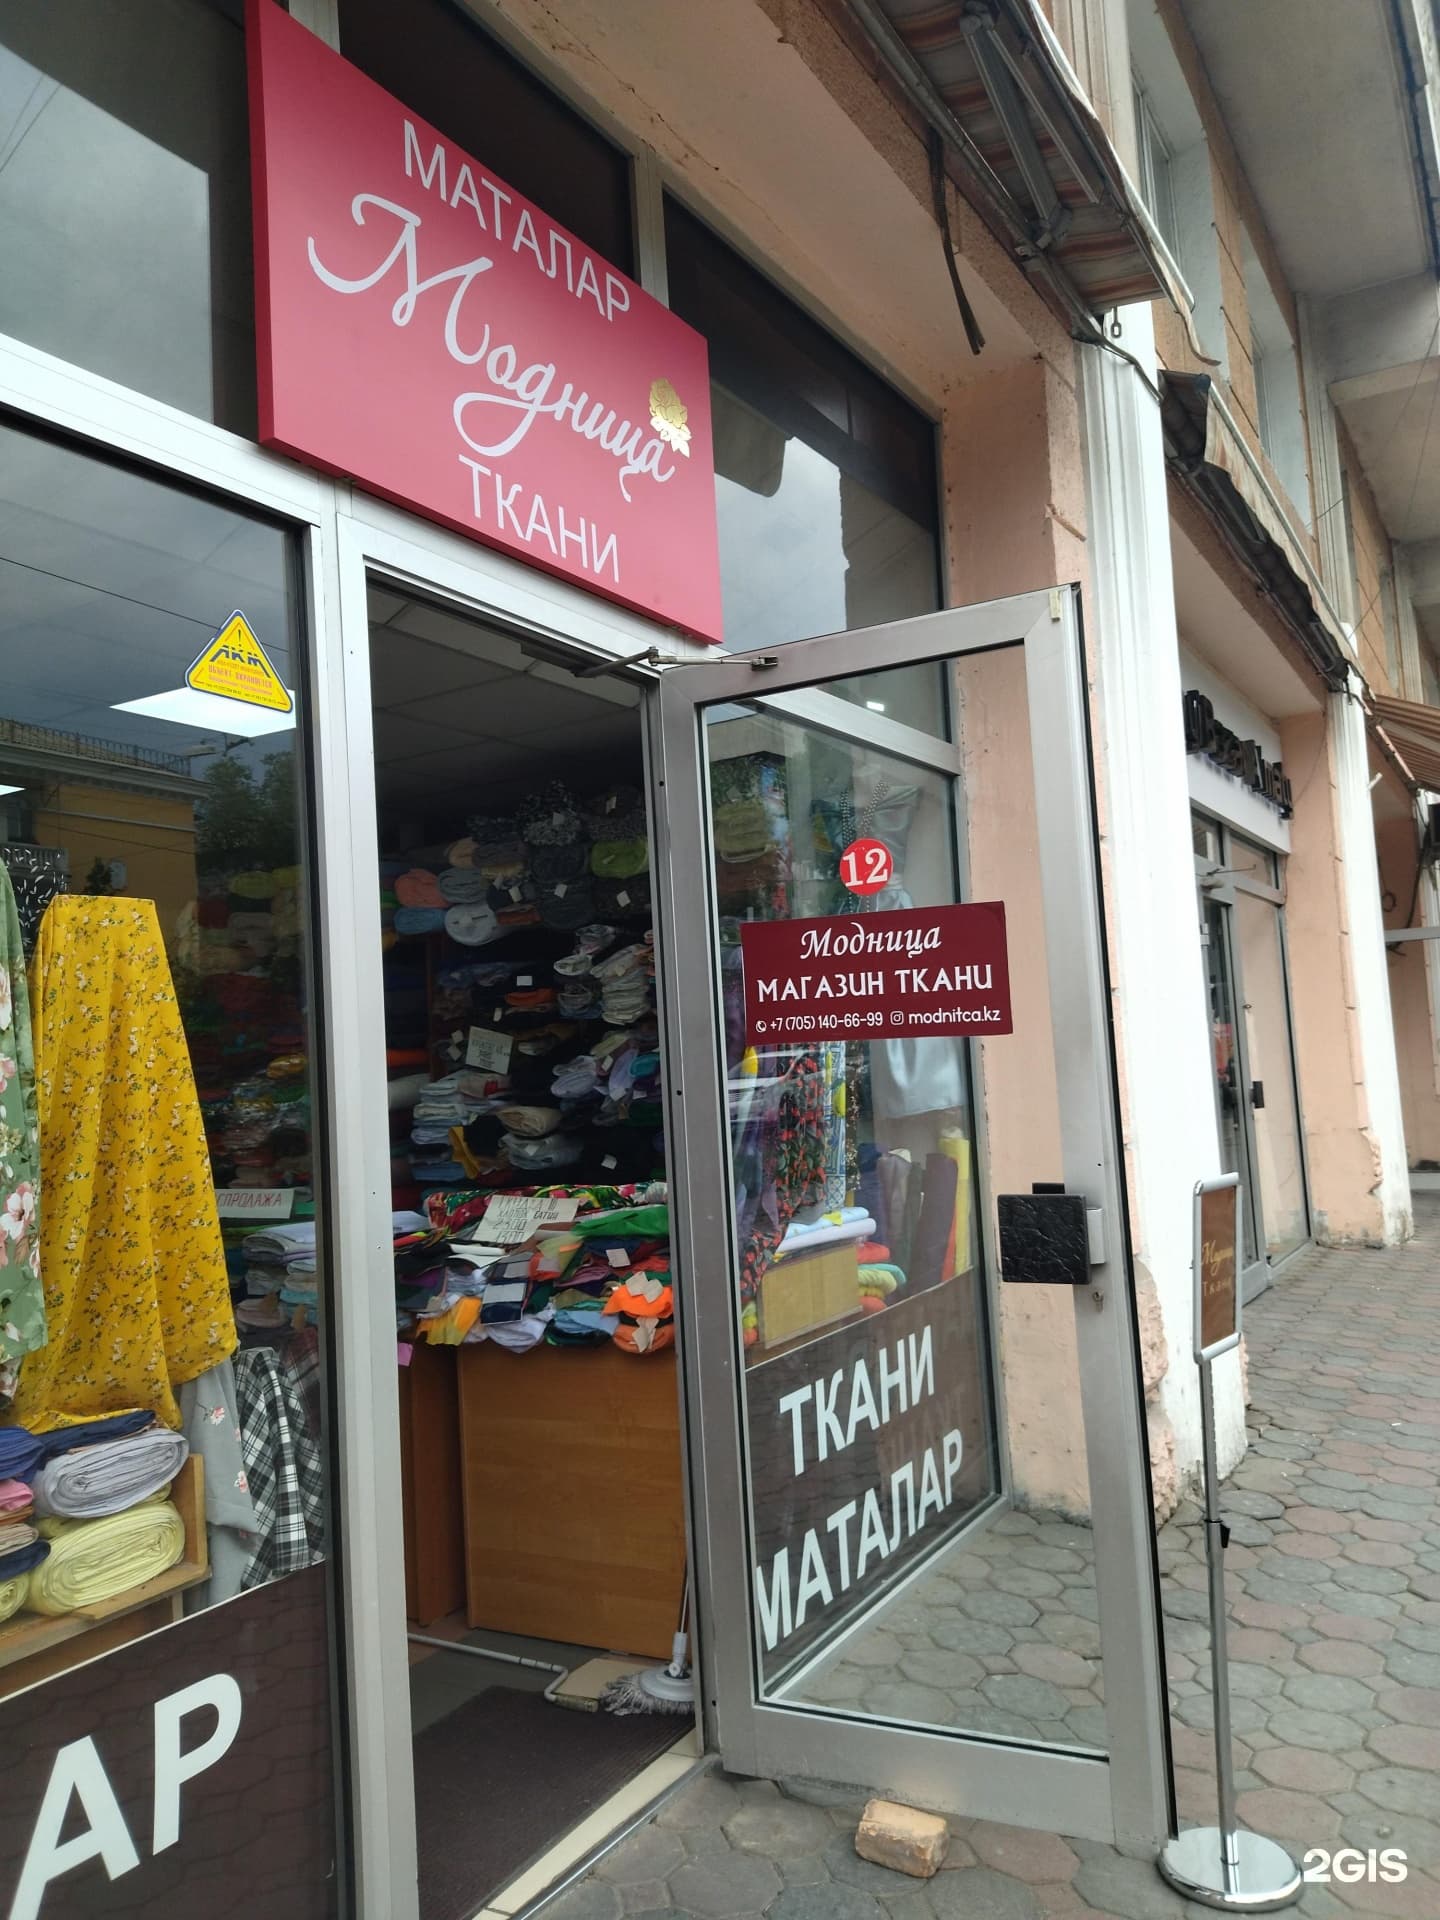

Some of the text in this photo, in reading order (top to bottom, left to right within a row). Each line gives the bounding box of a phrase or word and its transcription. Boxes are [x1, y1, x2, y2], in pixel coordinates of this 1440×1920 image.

[403, 118, 631, 322] МАТАЛАР
[307, 193, 676, 502] Модница
[458, 454, 621, 584] ТКАНИ
[842, 848, 888, 888] 12
[757, 964, 993, 1002] МАГАЗИН ТКАНИ
[800, 922, 942, 959] Модница
[770, 1006, 1001, 1032] +7 (705) 140-66-99 modnitca.kz
[779, 1325, 935, 1477] ТКАНИ
[756, 1428, 963, 1652] МАТАЛАР
[8, 1673, 242, 1920] АР
